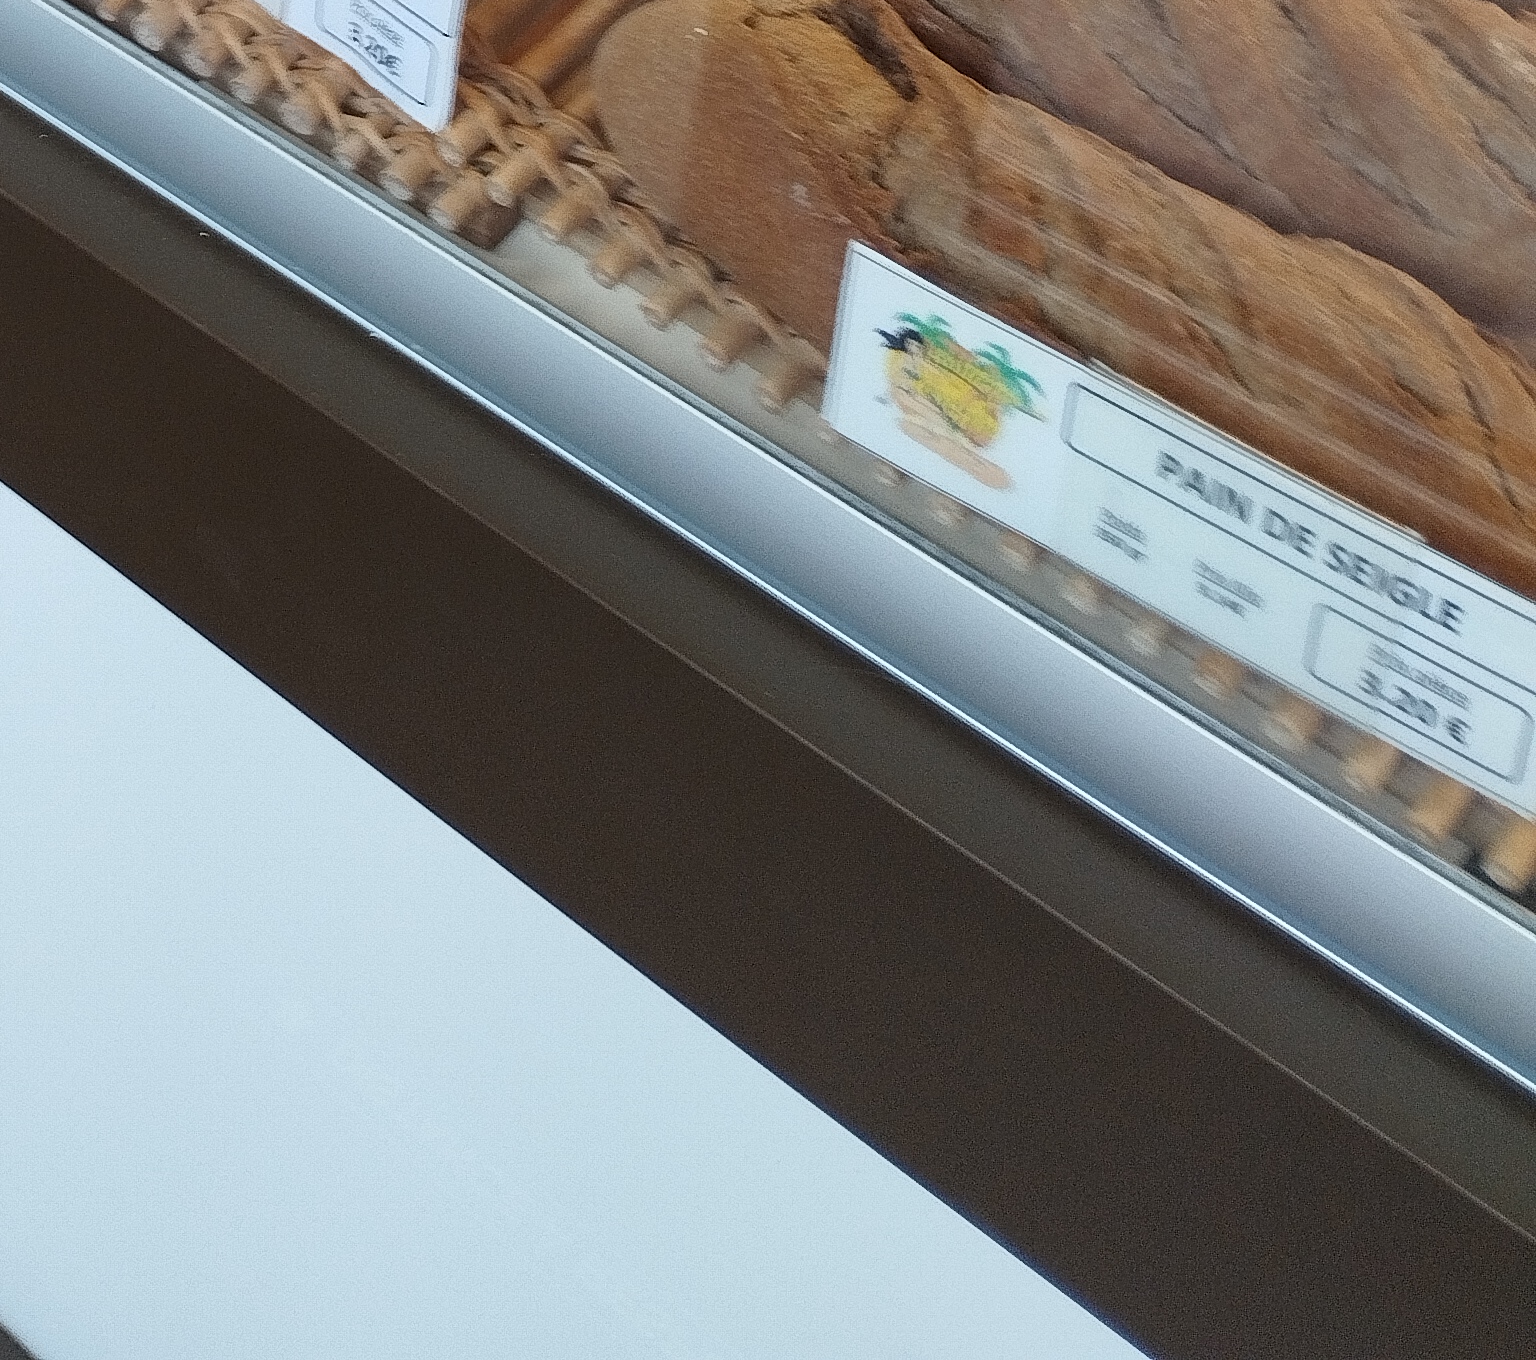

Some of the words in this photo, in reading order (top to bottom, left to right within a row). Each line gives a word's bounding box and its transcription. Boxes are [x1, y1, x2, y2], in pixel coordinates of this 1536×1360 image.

[1156, 448, 1256, 524] PAIN
[1260, 504, 1318, 560] DE
[1321, 539, 1468, 637] SEIGLE
[1444, 714, 1474, 746] €
